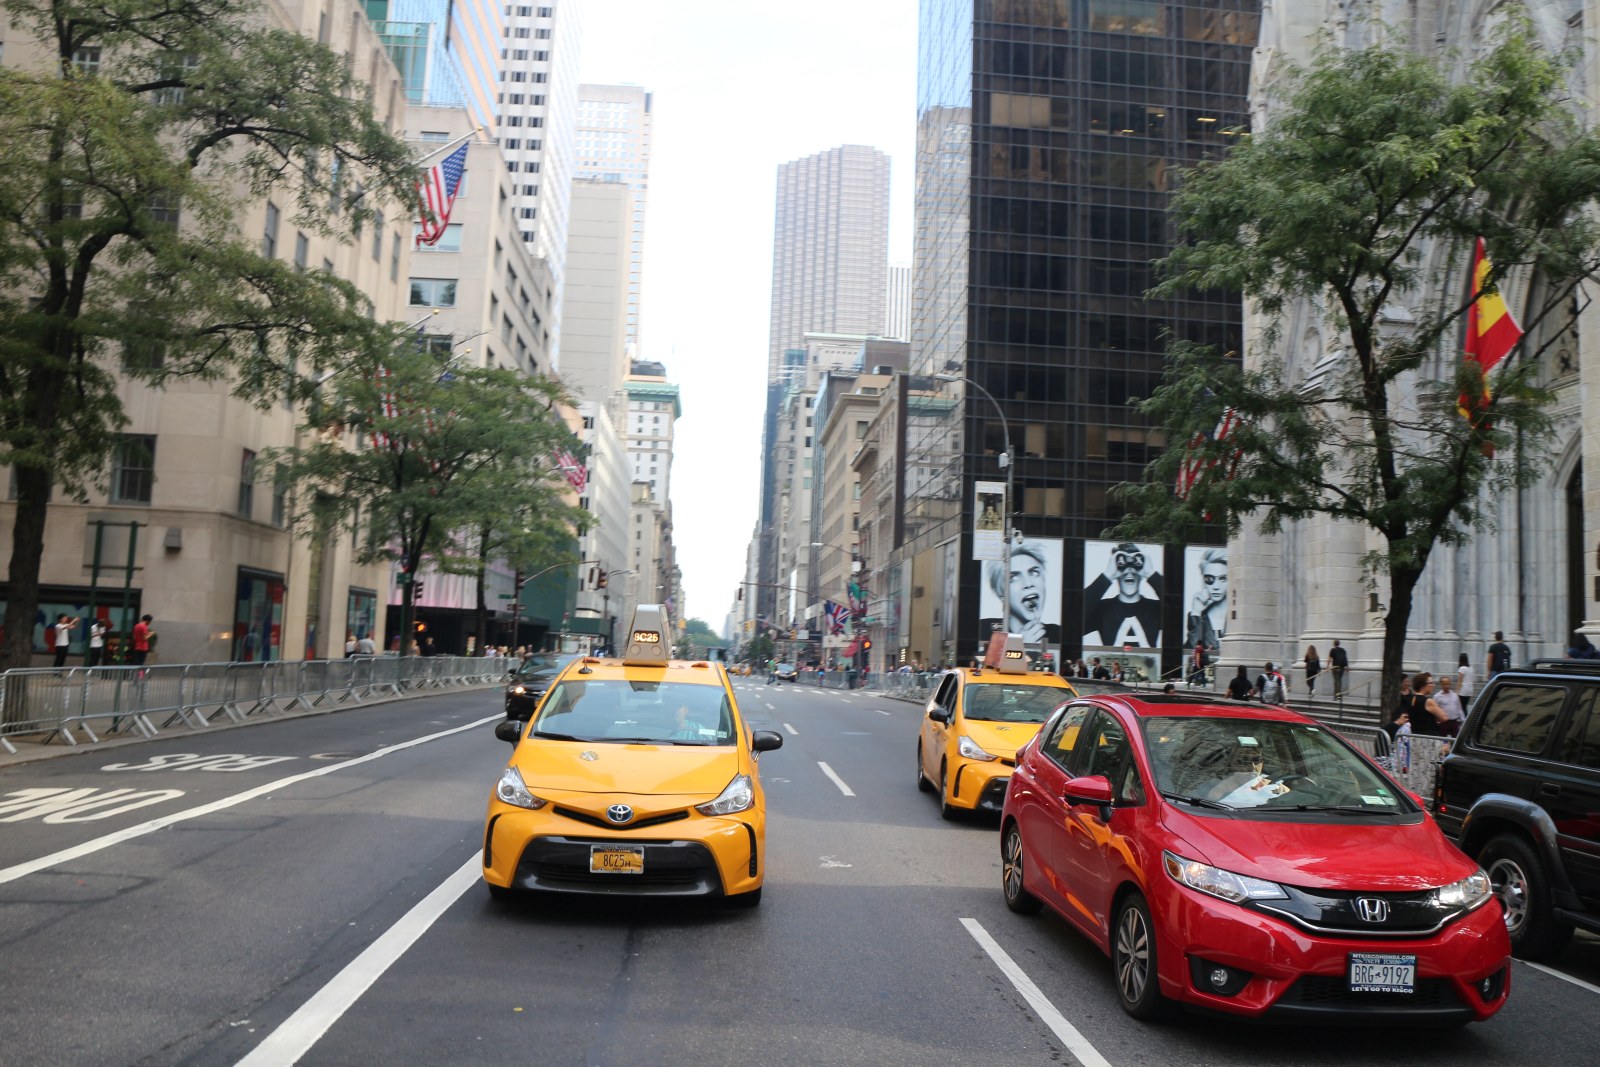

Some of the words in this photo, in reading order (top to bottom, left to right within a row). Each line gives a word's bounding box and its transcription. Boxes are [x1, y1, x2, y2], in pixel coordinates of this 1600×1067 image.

[634, 632, 659, 643] 8C25
[1113, 616, 1152, 648] A
[100, 753, 300, 772] BUS
[0, 787, 186, 825] ONL
